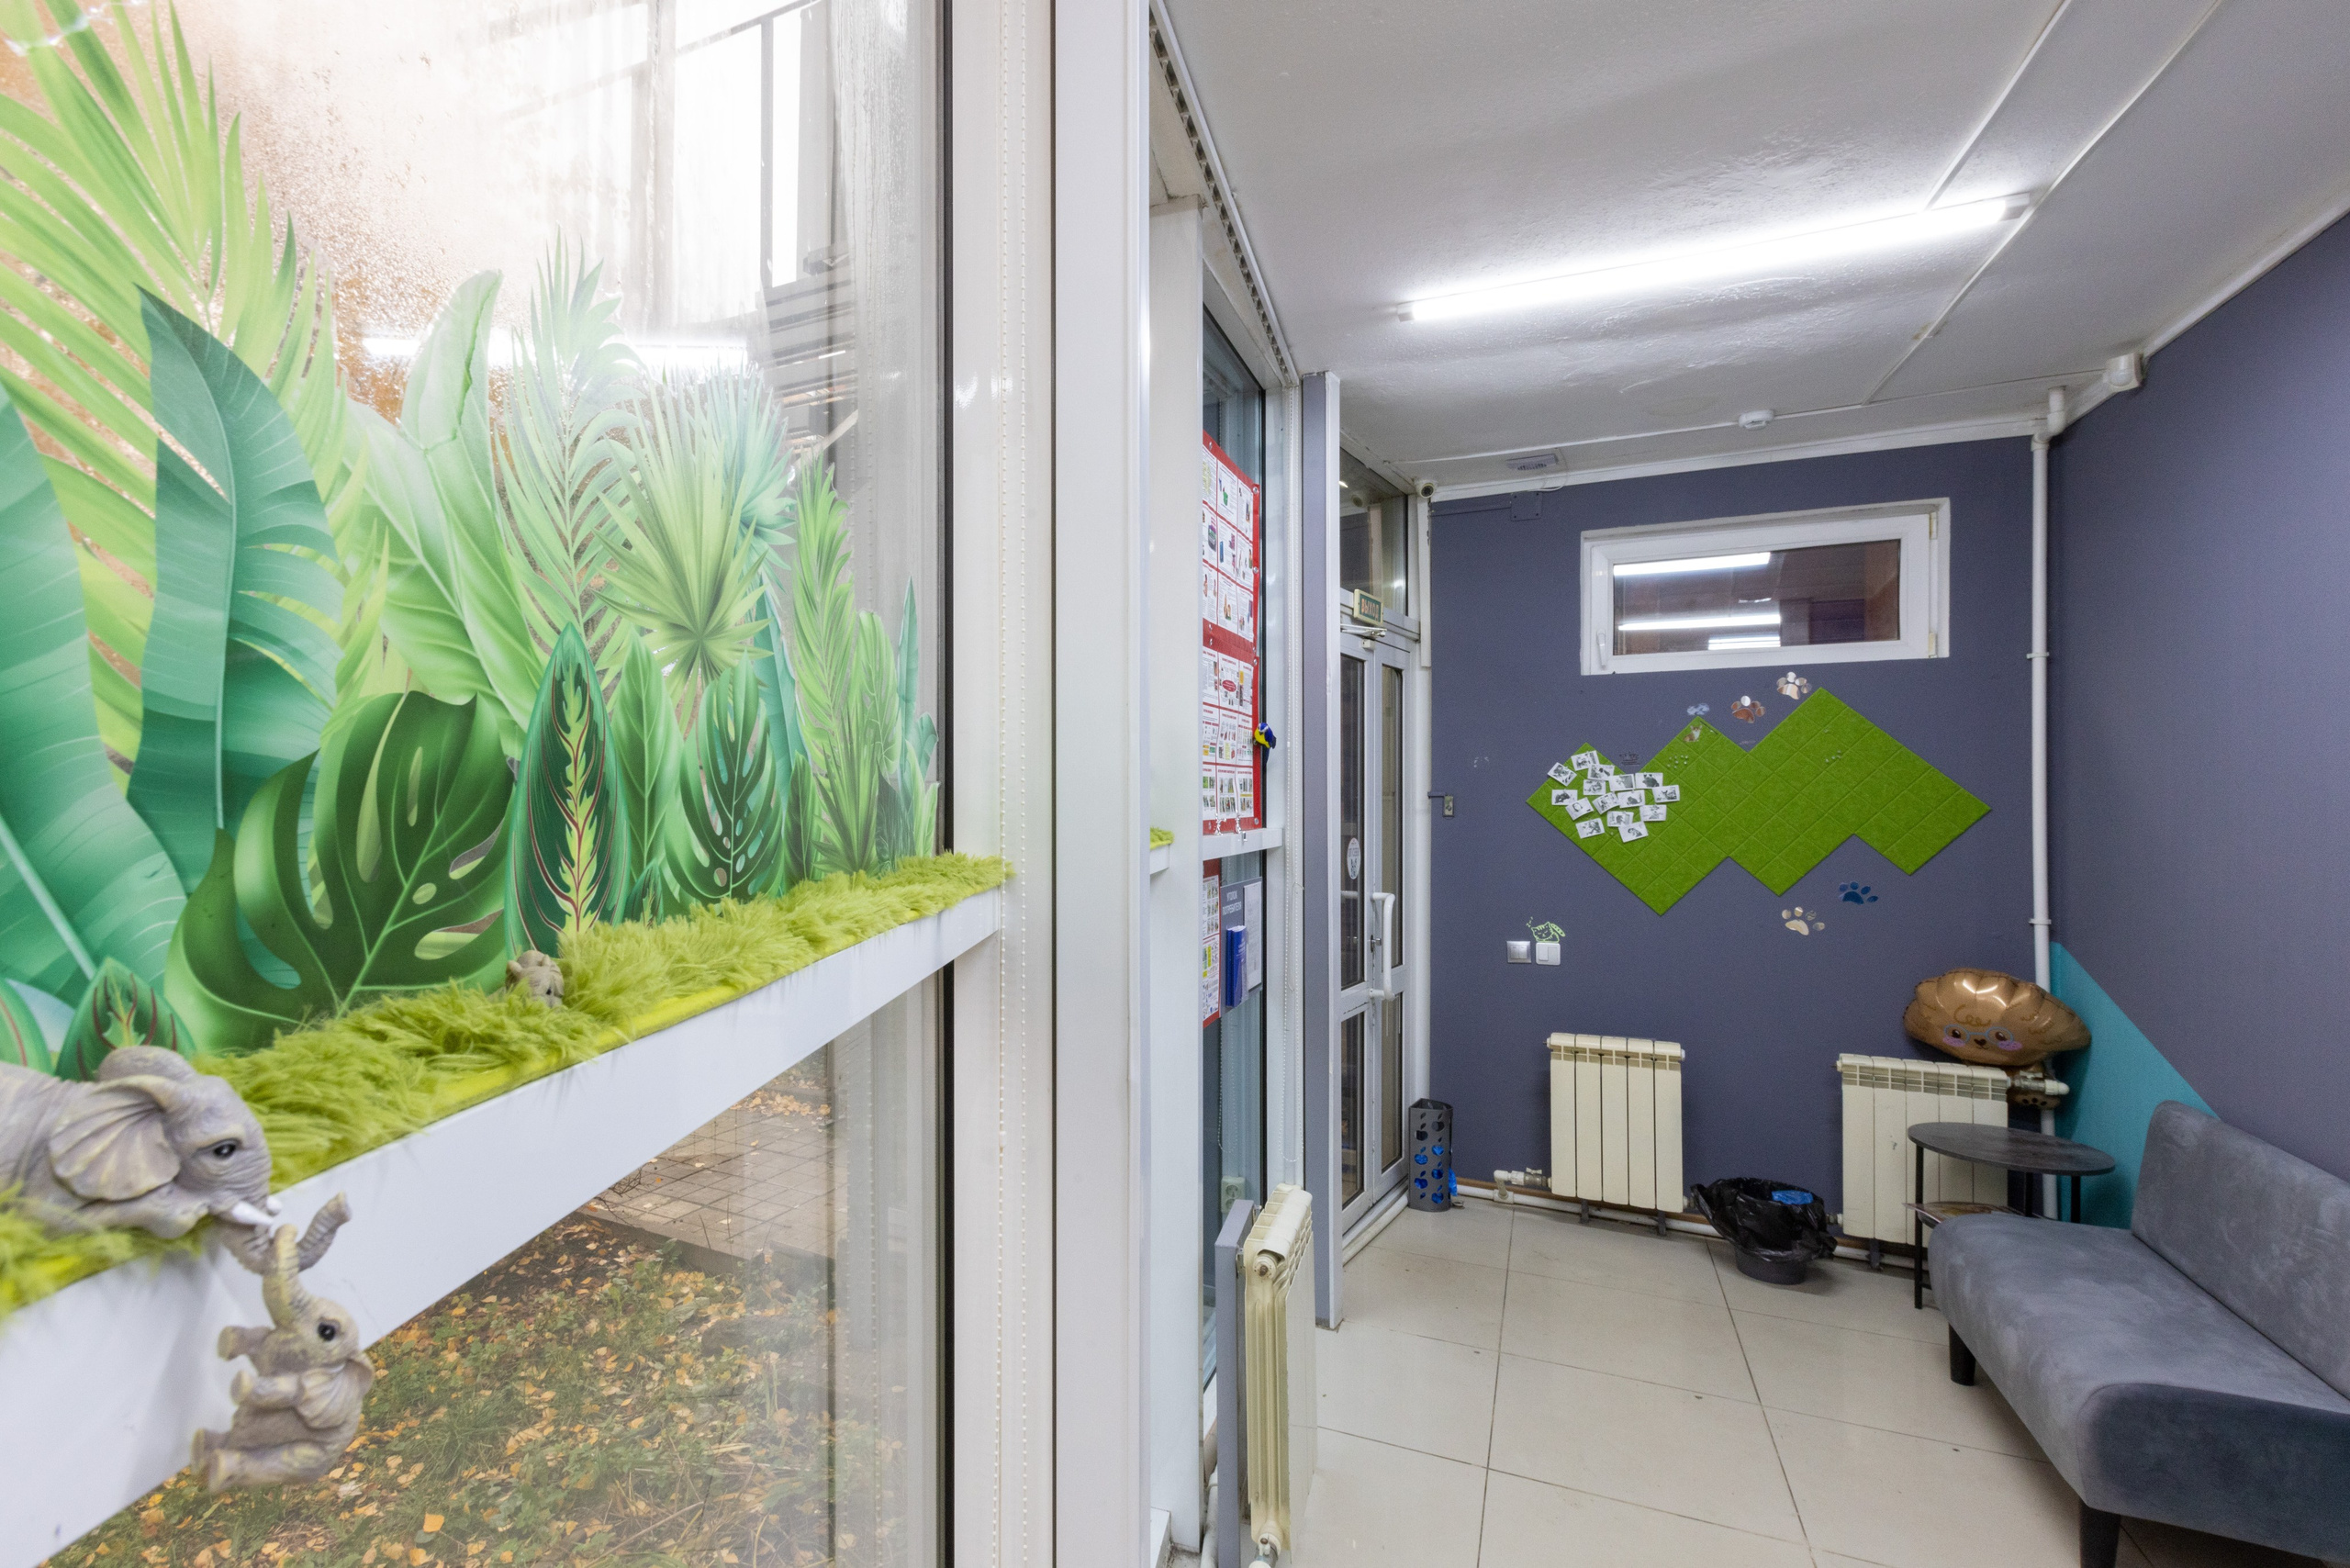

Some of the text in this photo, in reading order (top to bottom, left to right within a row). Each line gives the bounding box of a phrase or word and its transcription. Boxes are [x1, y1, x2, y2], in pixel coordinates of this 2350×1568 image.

[1361, 598, 1379, 621] ВЫХОД
[1226, 890, 1237, 902] УГОЛОК
[1222, 902, 1241, 915] ПОТРЕБИТЕЛЯ
